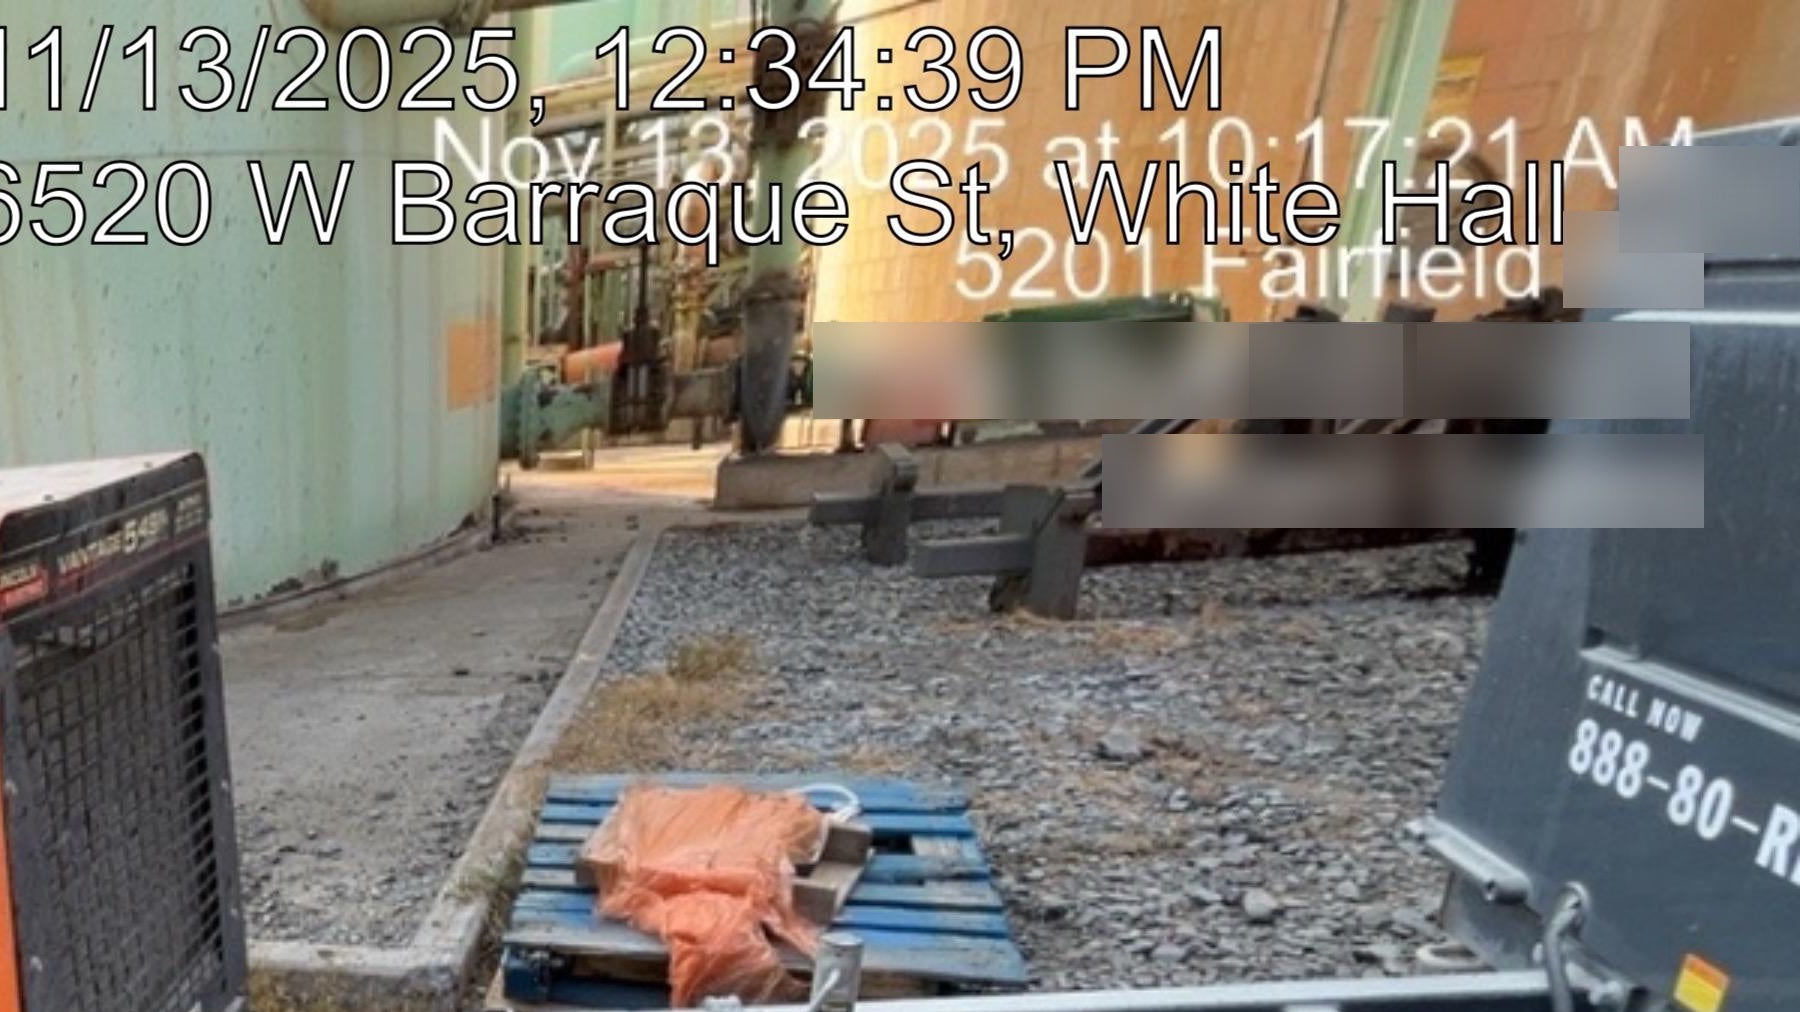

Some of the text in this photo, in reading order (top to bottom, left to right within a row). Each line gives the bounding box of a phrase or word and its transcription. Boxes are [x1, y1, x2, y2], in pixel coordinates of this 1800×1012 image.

[1587, 673, 1704, 742] CALL NOW
[1568, 718, 1800, 886] 888-80-R
